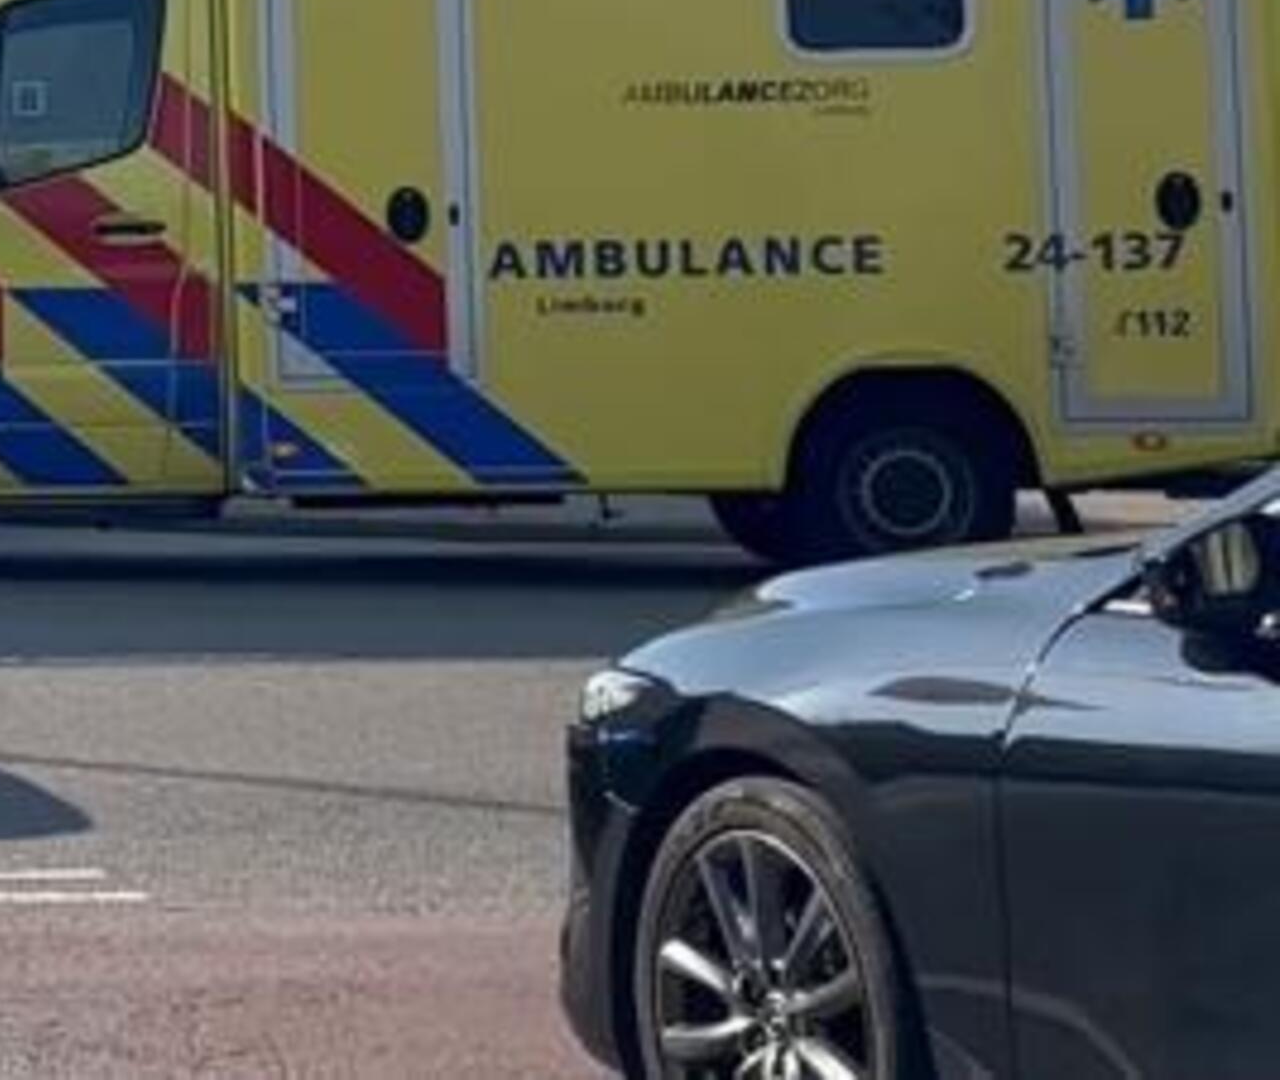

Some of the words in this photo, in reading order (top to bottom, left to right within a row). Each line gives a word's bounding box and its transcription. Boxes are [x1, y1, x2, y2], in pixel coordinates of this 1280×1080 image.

[623, 77, 870, 105] AMBULANCEZORG
[489, 234, 885, 279] AMBULANCE
[1003, 232, 1185, 272] 24-137
[536, 296, 647, 317] Limburg
